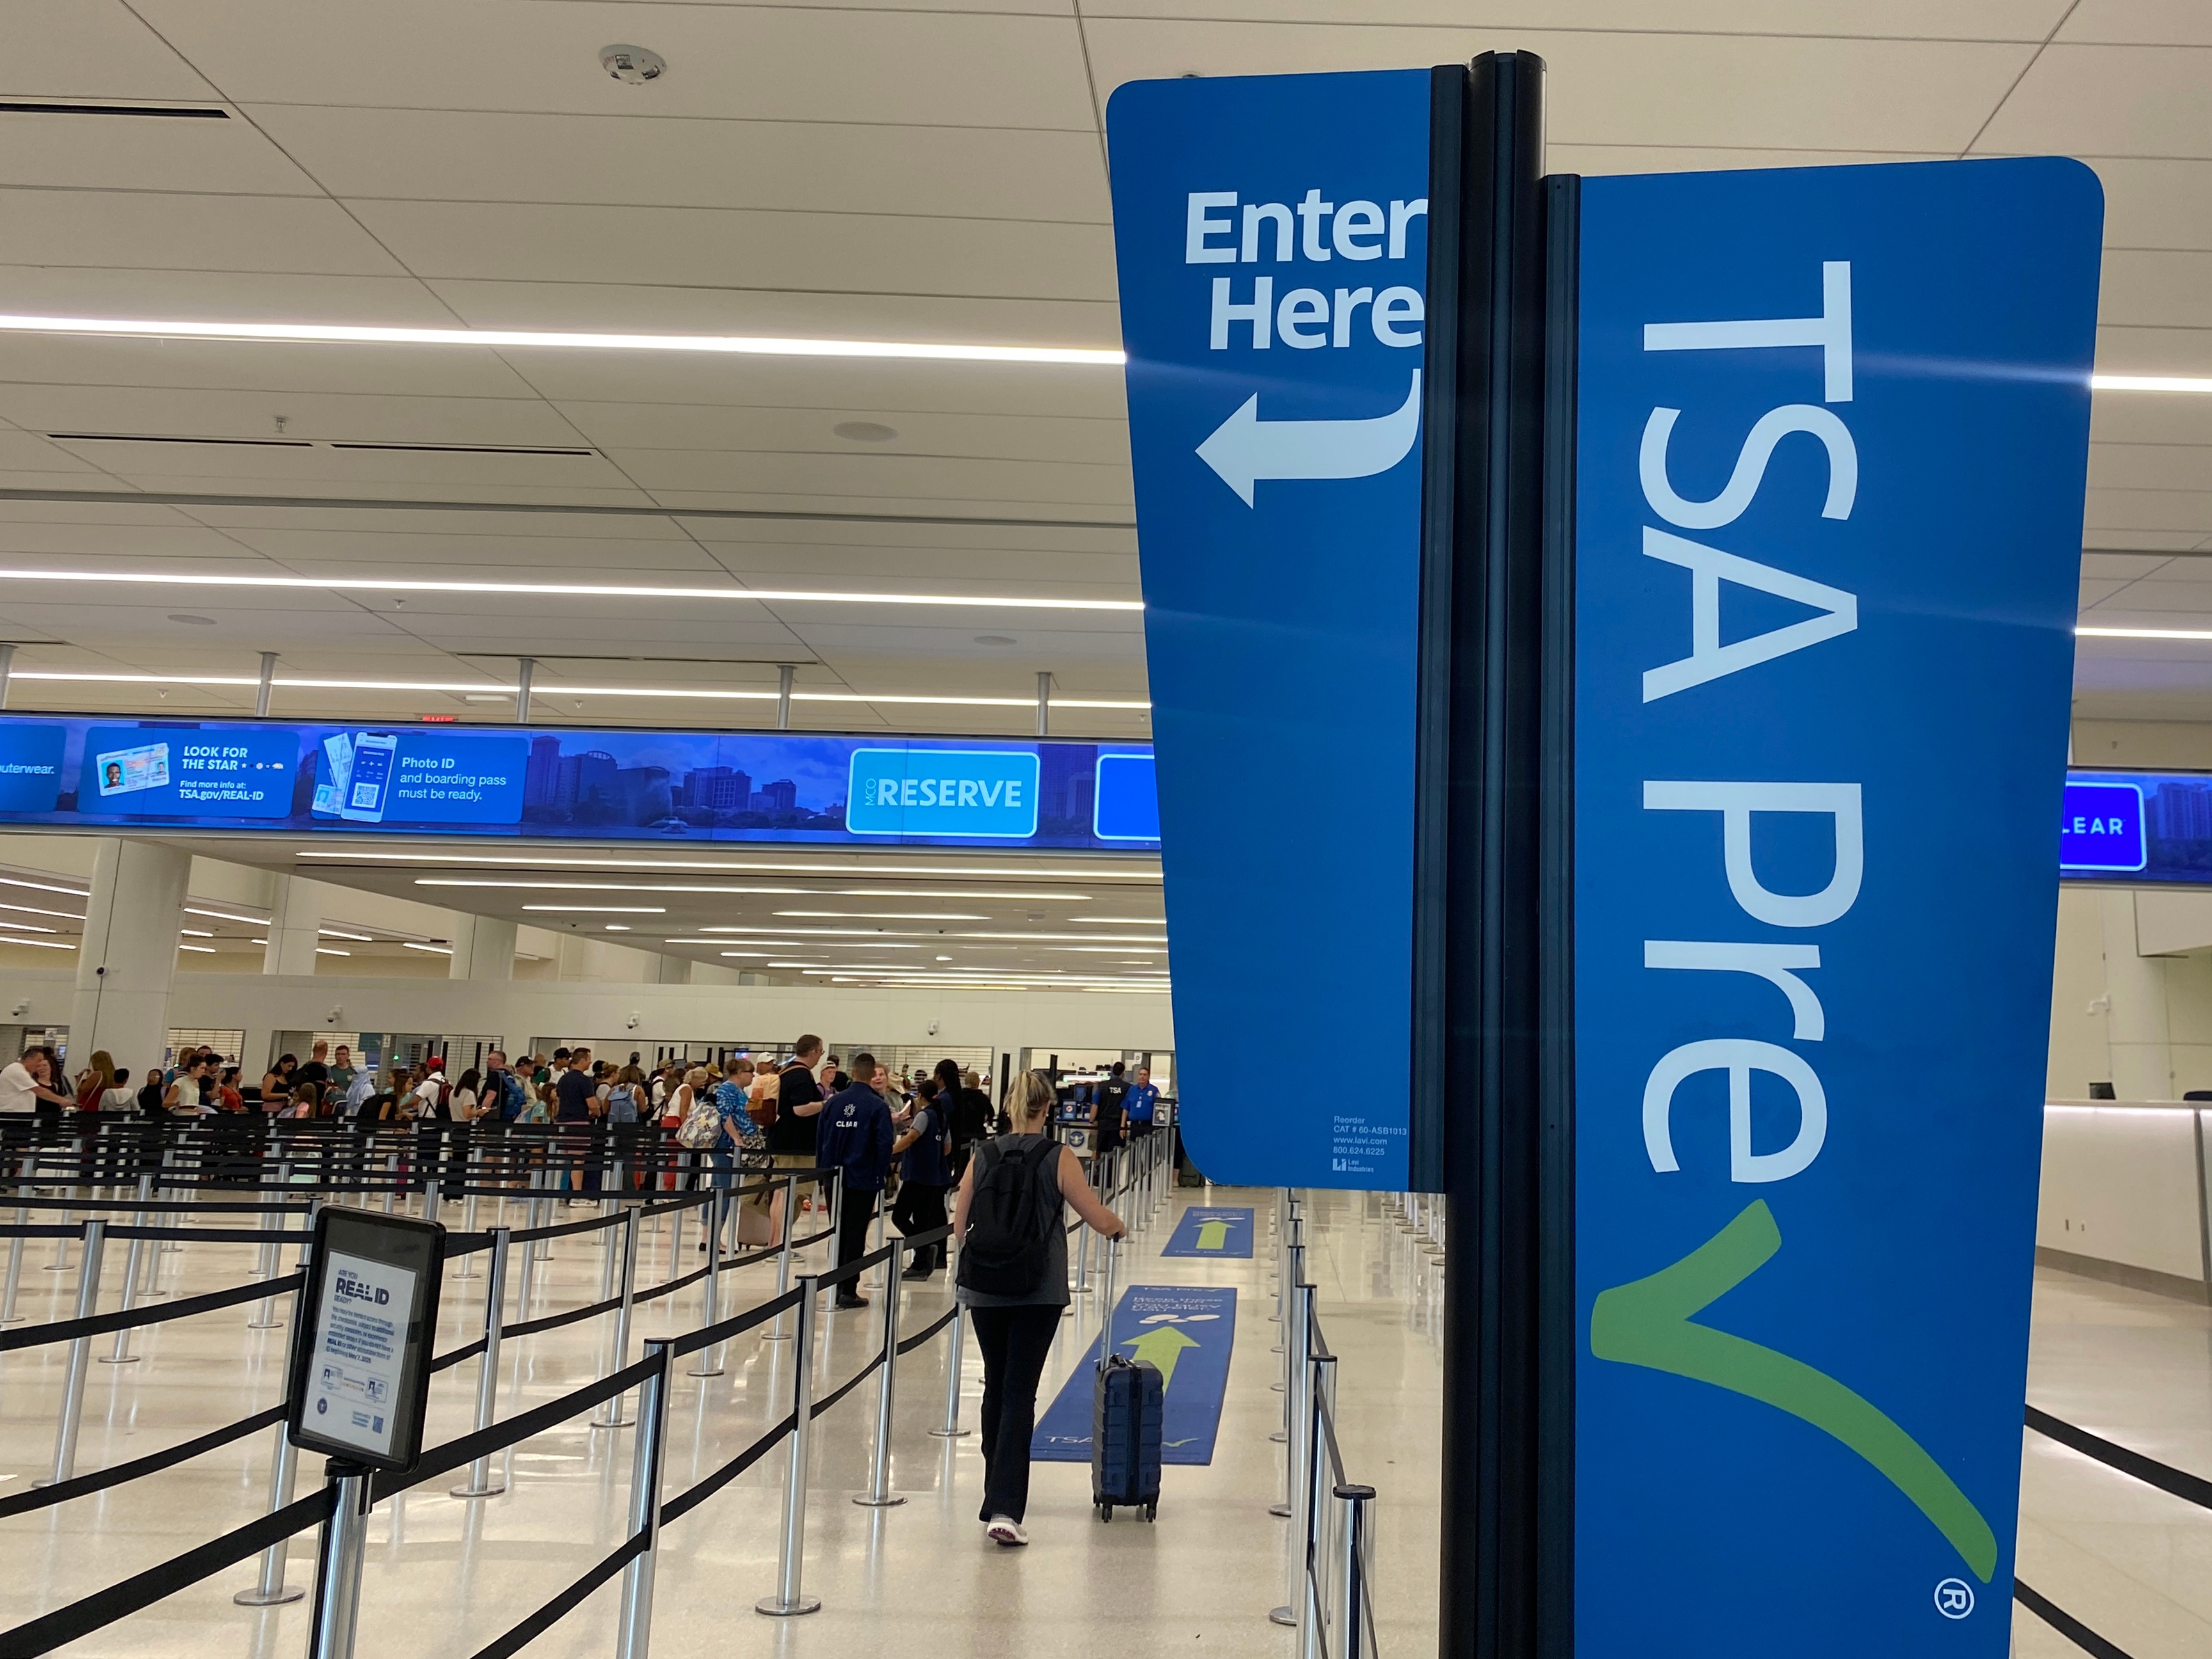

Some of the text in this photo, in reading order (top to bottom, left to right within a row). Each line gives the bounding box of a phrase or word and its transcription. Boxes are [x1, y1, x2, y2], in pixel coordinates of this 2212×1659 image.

[1186, 189, 1429, 264] Enter
[1210, 276, 1425, 350] Here
[1639, 261, 1863, 1184] TSA Pre
[184, 745, 248, 758] LOOK FOR
[182, 758, 238, 770] THE STAR
[402, 757, 455, 769] Photo ID
[180, 780, 197, 788] Find
[219, 781, 235, 789] info
[400, 773, 507, 788] and boarding pass
[179, 789, 264, 801] TSA.gov/REAL-ID
[398, 788, 482, 802] must be ready.
[865, 778, 877, 806] MCO
[877, 778, 1022, 807] RESERVE
[1333, 1115, 1365, 1124] Reorder
[1333, 1125, 1349, 1133] CAT
[1358, 1126, 1407, 1136] 60-ASB1013
[1333, 1136, 1387, 1145] www.lavi.com
[1333, 1146, 1385, 1155] 800.624.6225
[336, 1277, 390, 1305] REAL ID
[1045, 1436, 1094, 1444] TSA
